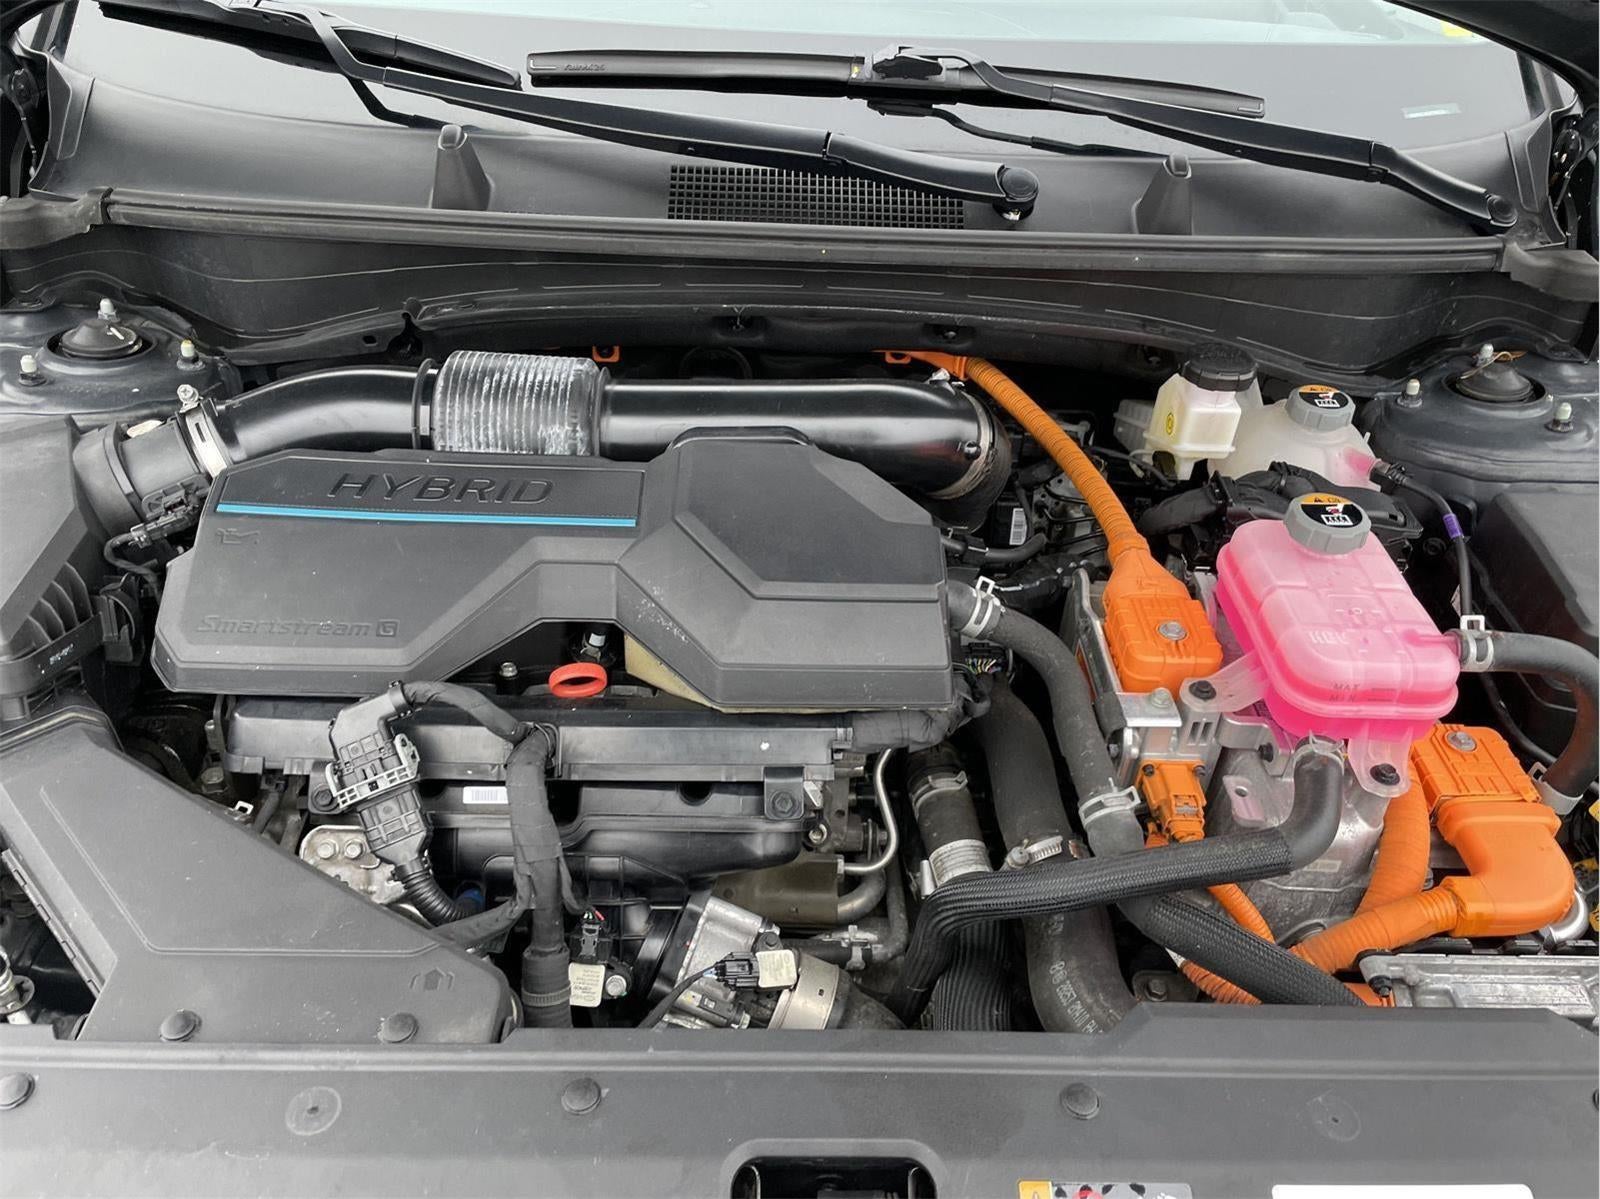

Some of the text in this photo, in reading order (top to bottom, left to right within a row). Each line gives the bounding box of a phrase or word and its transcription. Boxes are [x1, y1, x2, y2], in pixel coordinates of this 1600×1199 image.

[327, 473, 554, 505] HYBRID
[197, 614, 373, 638] Smartstream
[1333, 683, 1360, 691] MAX
[1329, 693, 1357, 702] MIN
